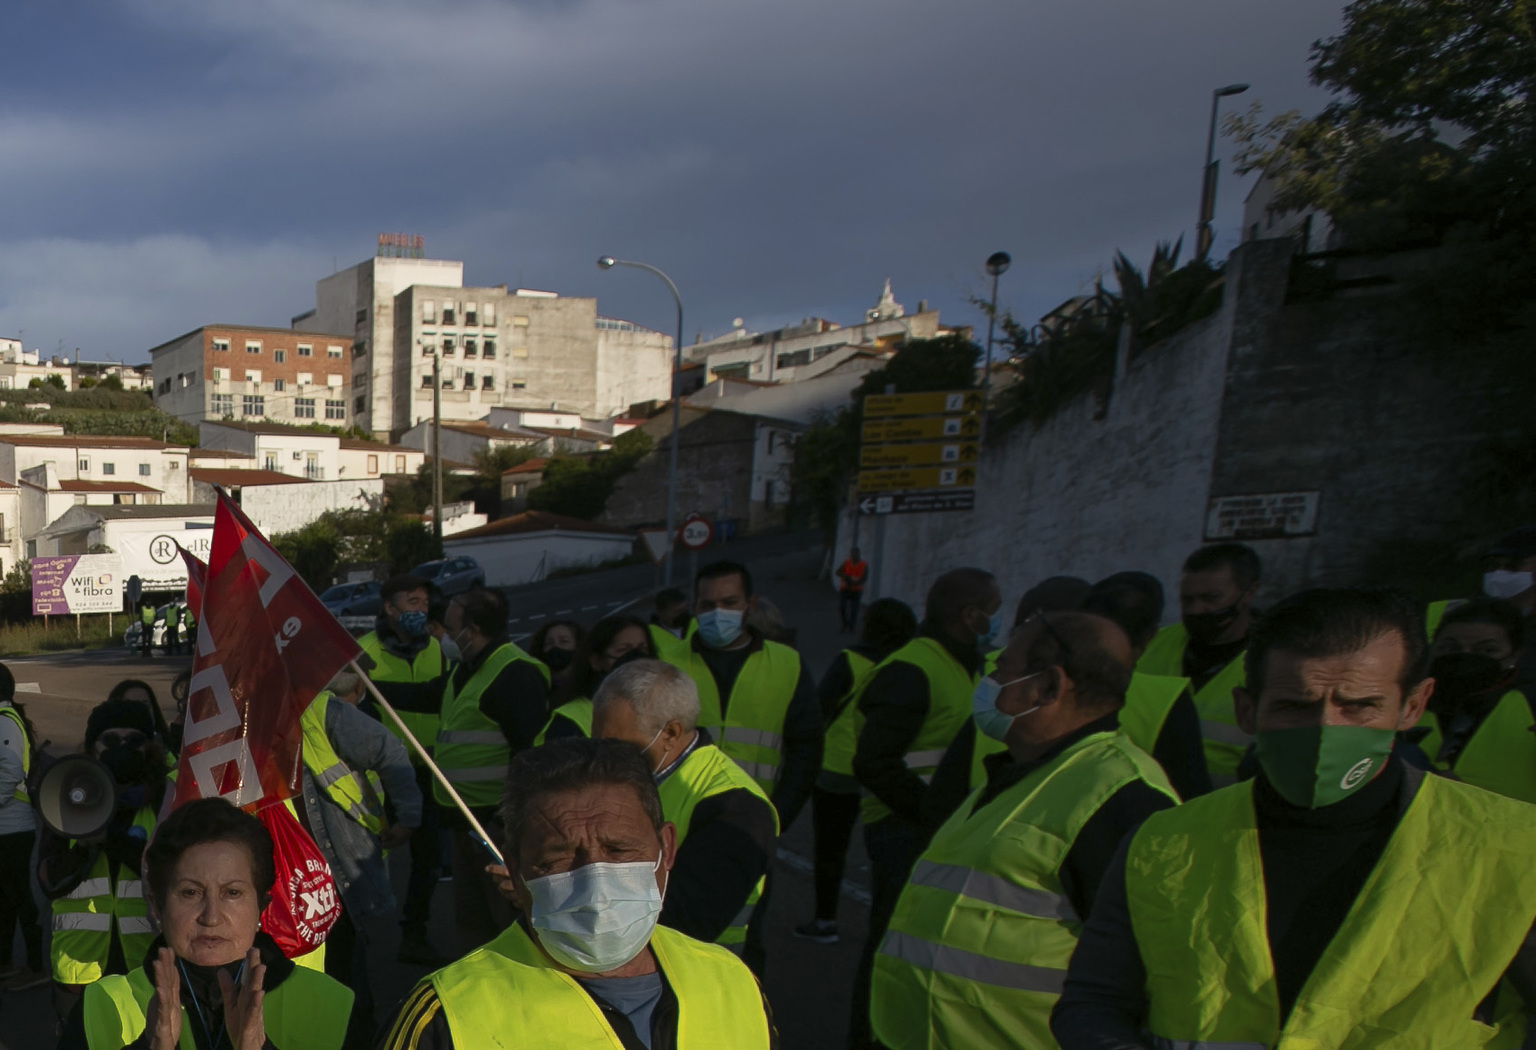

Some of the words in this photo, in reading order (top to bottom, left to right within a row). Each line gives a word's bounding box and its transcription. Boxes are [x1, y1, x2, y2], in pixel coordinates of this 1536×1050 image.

[71, 576, 94, 587] Wifi
[83, 584, 113, 596] fibra
[299, 882, 335, 920] Xti
